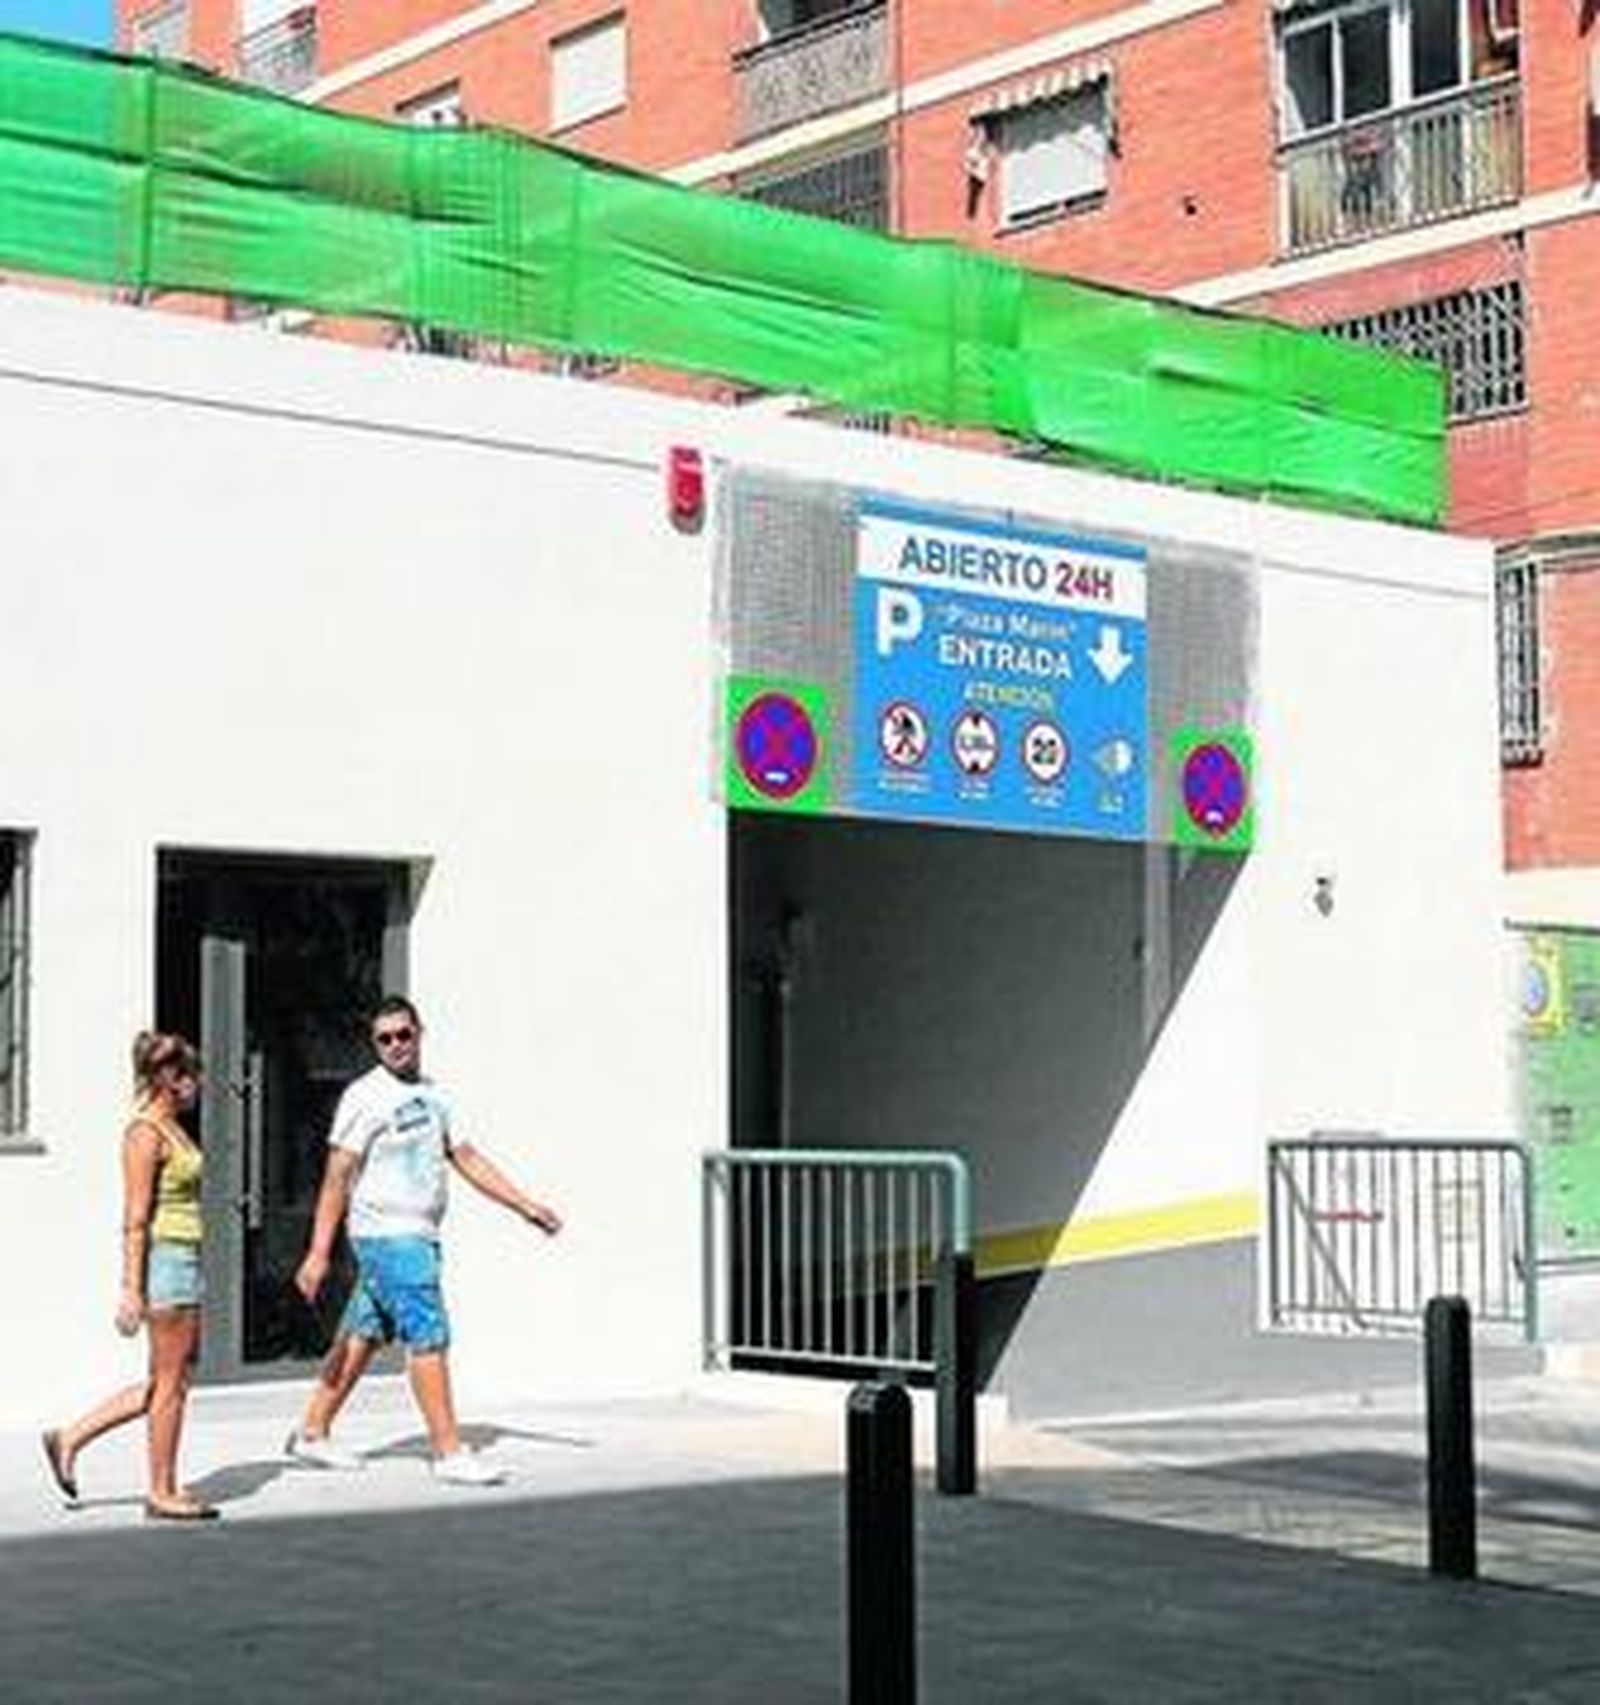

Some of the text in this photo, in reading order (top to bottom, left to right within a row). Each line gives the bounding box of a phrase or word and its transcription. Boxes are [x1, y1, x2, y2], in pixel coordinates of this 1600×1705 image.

[898, 537, 1114, 600] ABIERTO 24H
[876, 588, 923, 658] P
[938, 634, 1072, 680] ENTRADA
